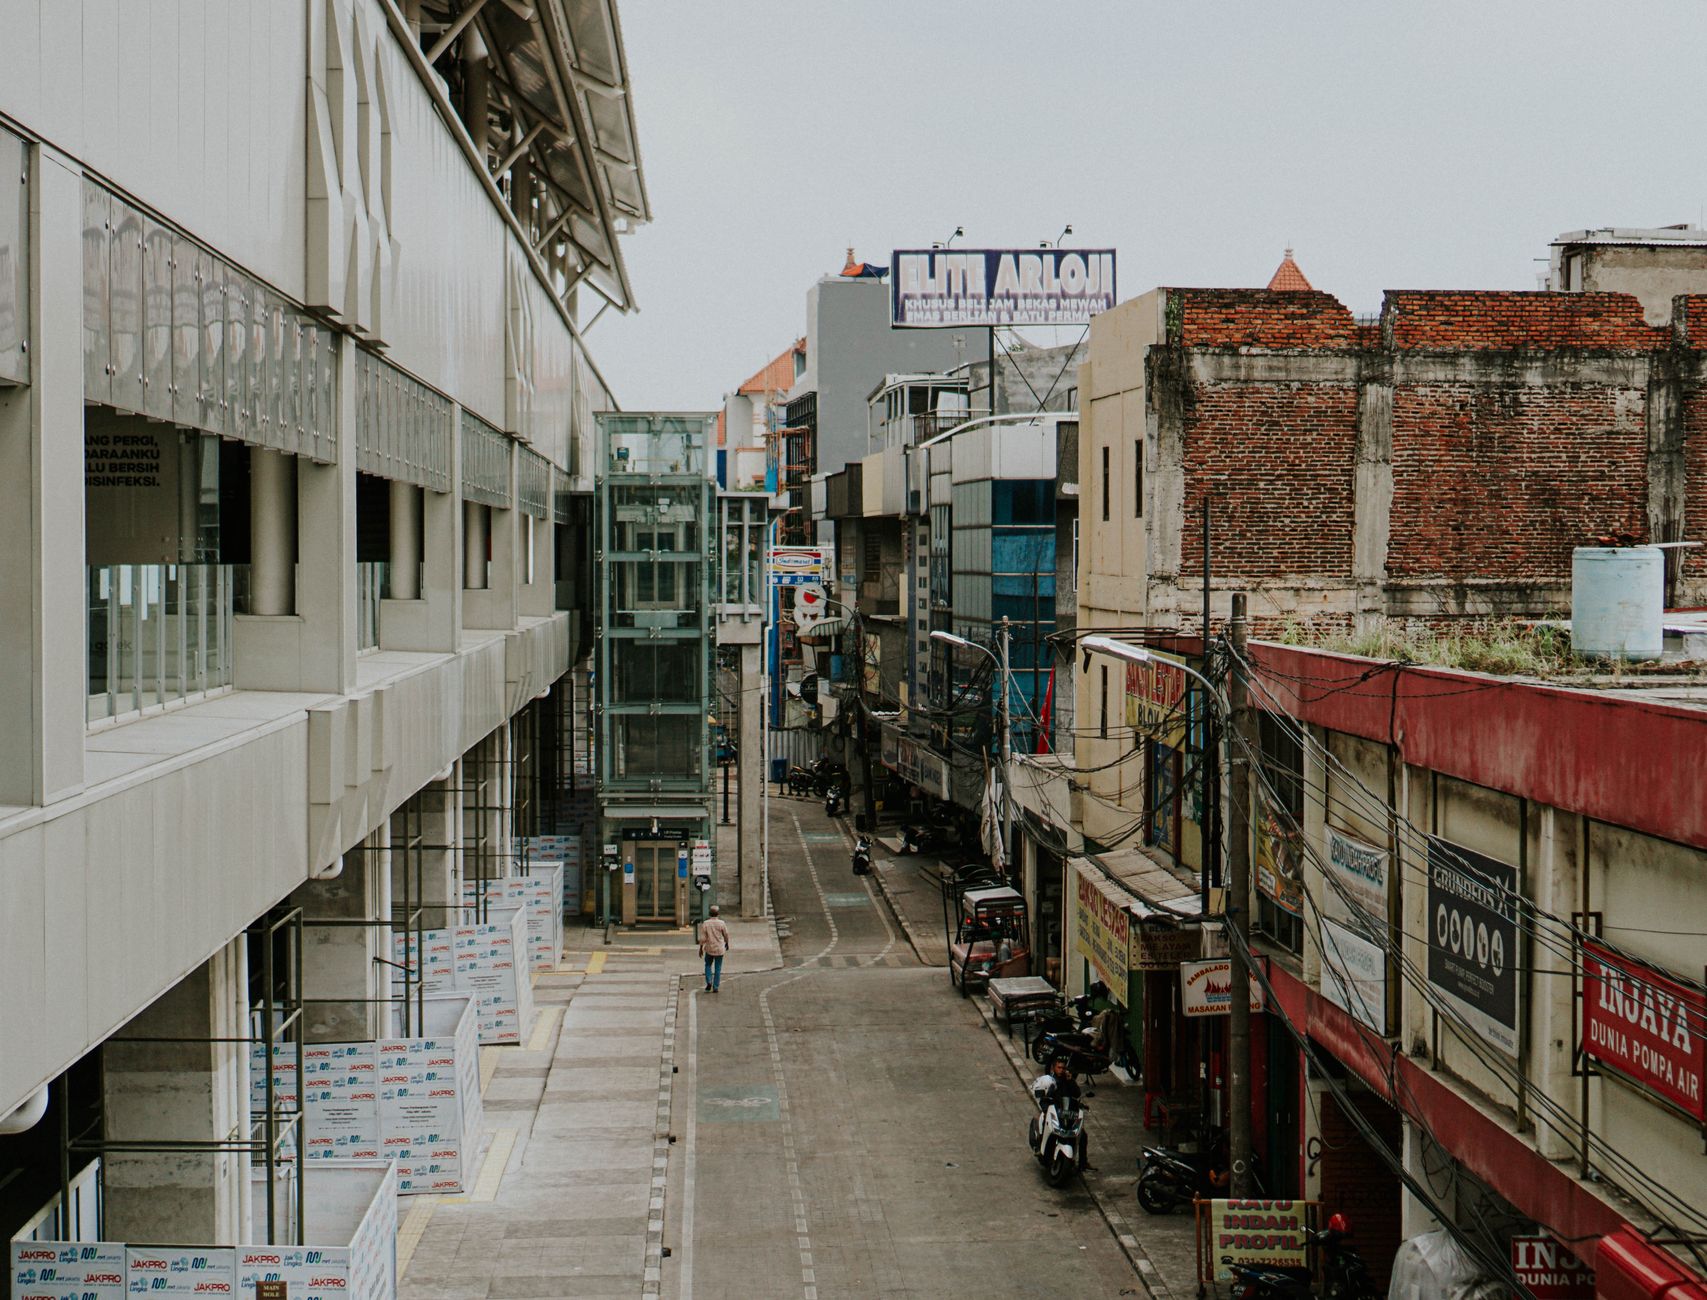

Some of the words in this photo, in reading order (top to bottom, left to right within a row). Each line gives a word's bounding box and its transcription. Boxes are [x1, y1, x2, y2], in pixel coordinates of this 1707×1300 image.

[899, 253, 986, 294] ELITE
[994, 253, 1113, 294] ARLOJI
[906, 299, 954, 310] KHUSUS
[956, 299, 986, 310] BELI
[988, 299, 1014, 310] JAM
[1018, 299, 1056, 310] BEKAS
[1060, 299, 1106, 310] MEWAH
[906, 311, 938, 322] EMAS
[944, 311, 998, 322] BERLIAN
[1013, 311, 1046, 322] BATU
[112, 435, 158, 446] PERGI,
[109, 463, 159, 473] BERSIH
[1187, 964, 1229, 986] SAMBALADO
[1600, 964, 1692, 1054] INJAYA
[1591, 1018, 1628, 1059] DUNIA
[1634, 1039, 1673, 1086] POMPA
[1677, 1067, 1698, 1101] AIR
[1223, 1215, 1298, 1230] INDAH
[1220, 1234, 1304, 1250] PROFIL
[18, 1251, 56, 1259] JAKPRO
[242, 1255, 280, 1264] JAKPRO
[131, 1260, 167, 1269] JAKPRO
[84, 1274, 122, 1283] JAKPRO
[308, 1278, 346, 1287] JAKPRO
[1516, 1273, 1570, 1285] DUNIA
[194, 1283, 230, 1292] JAKPRO
